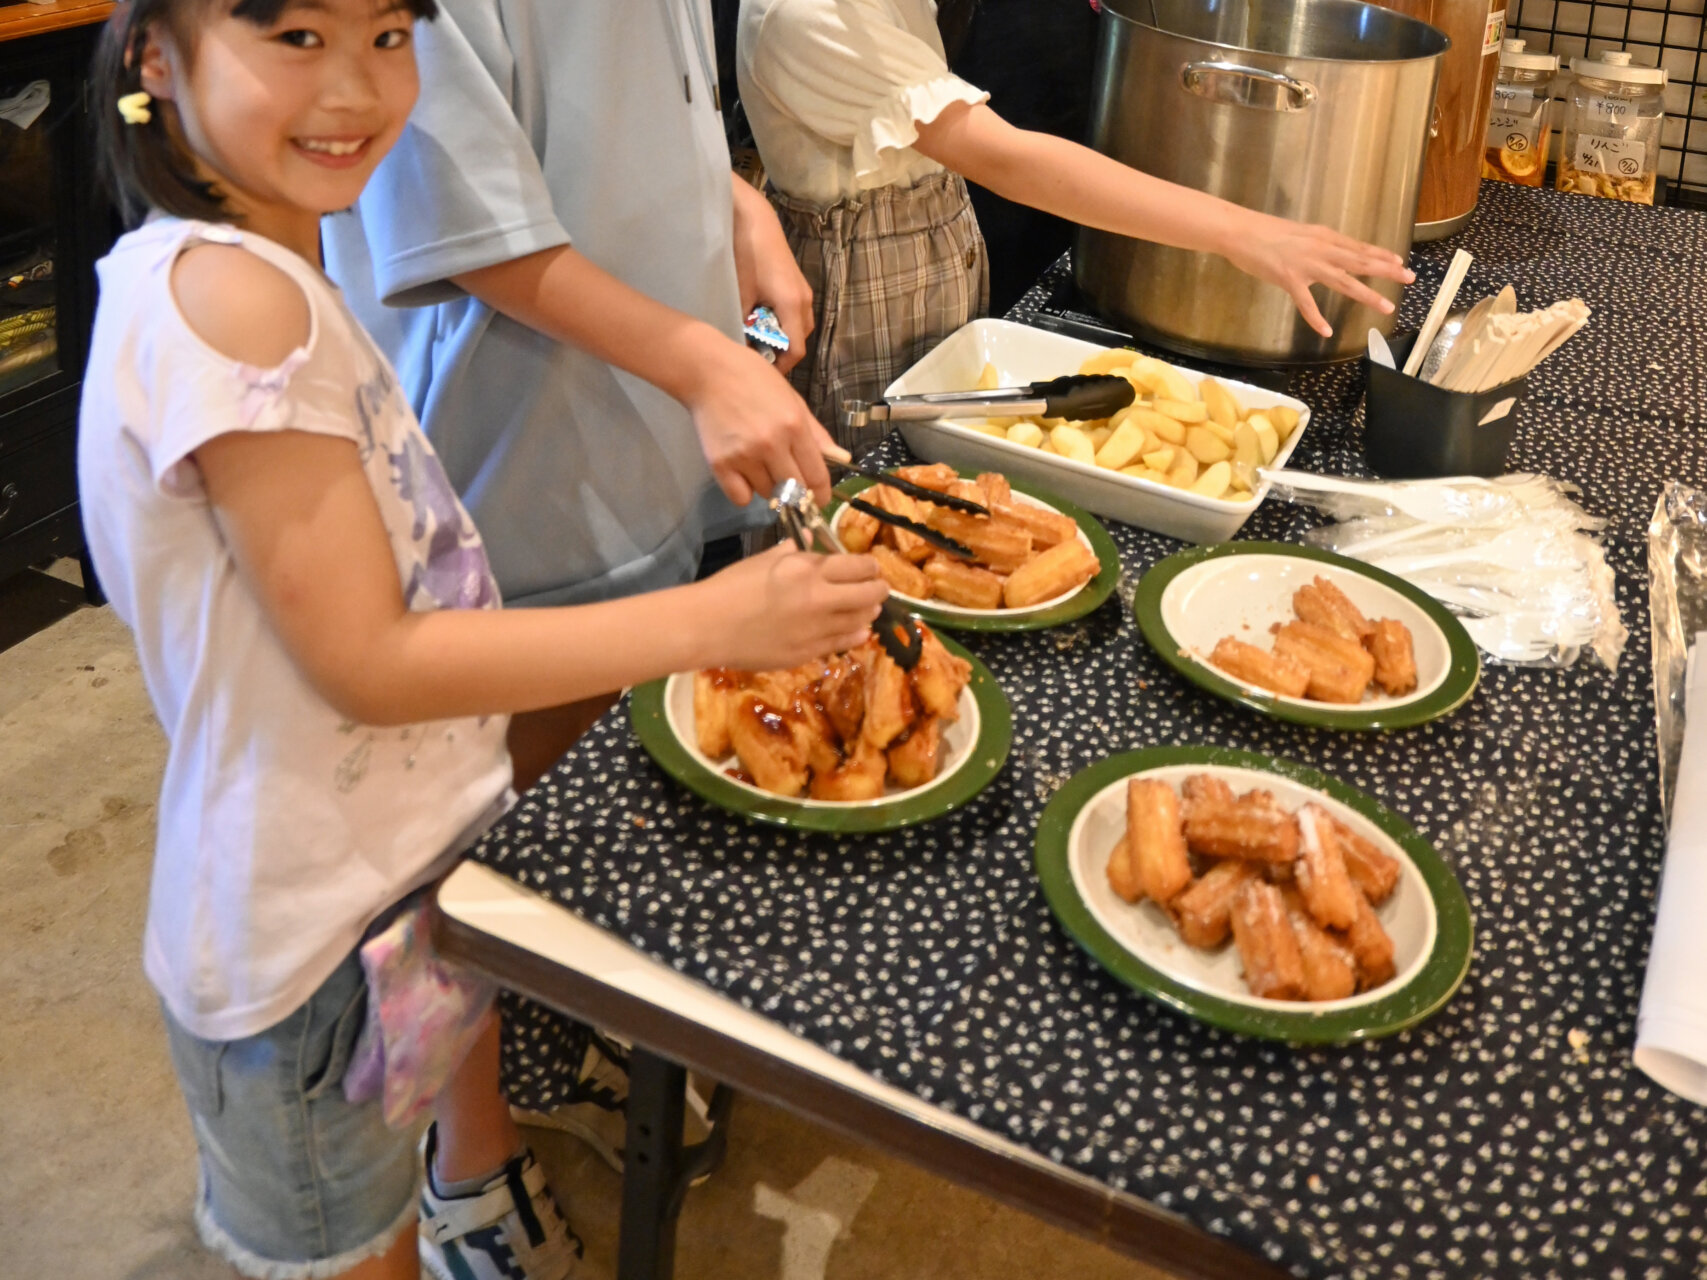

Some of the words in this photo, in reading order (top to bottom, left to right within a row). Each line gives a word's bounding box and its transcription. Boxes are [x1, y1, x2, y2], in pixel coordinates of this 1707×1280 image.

[1596, 101, 1626, 115] ¥800
[1591, 138, 1629, 153] りんご
